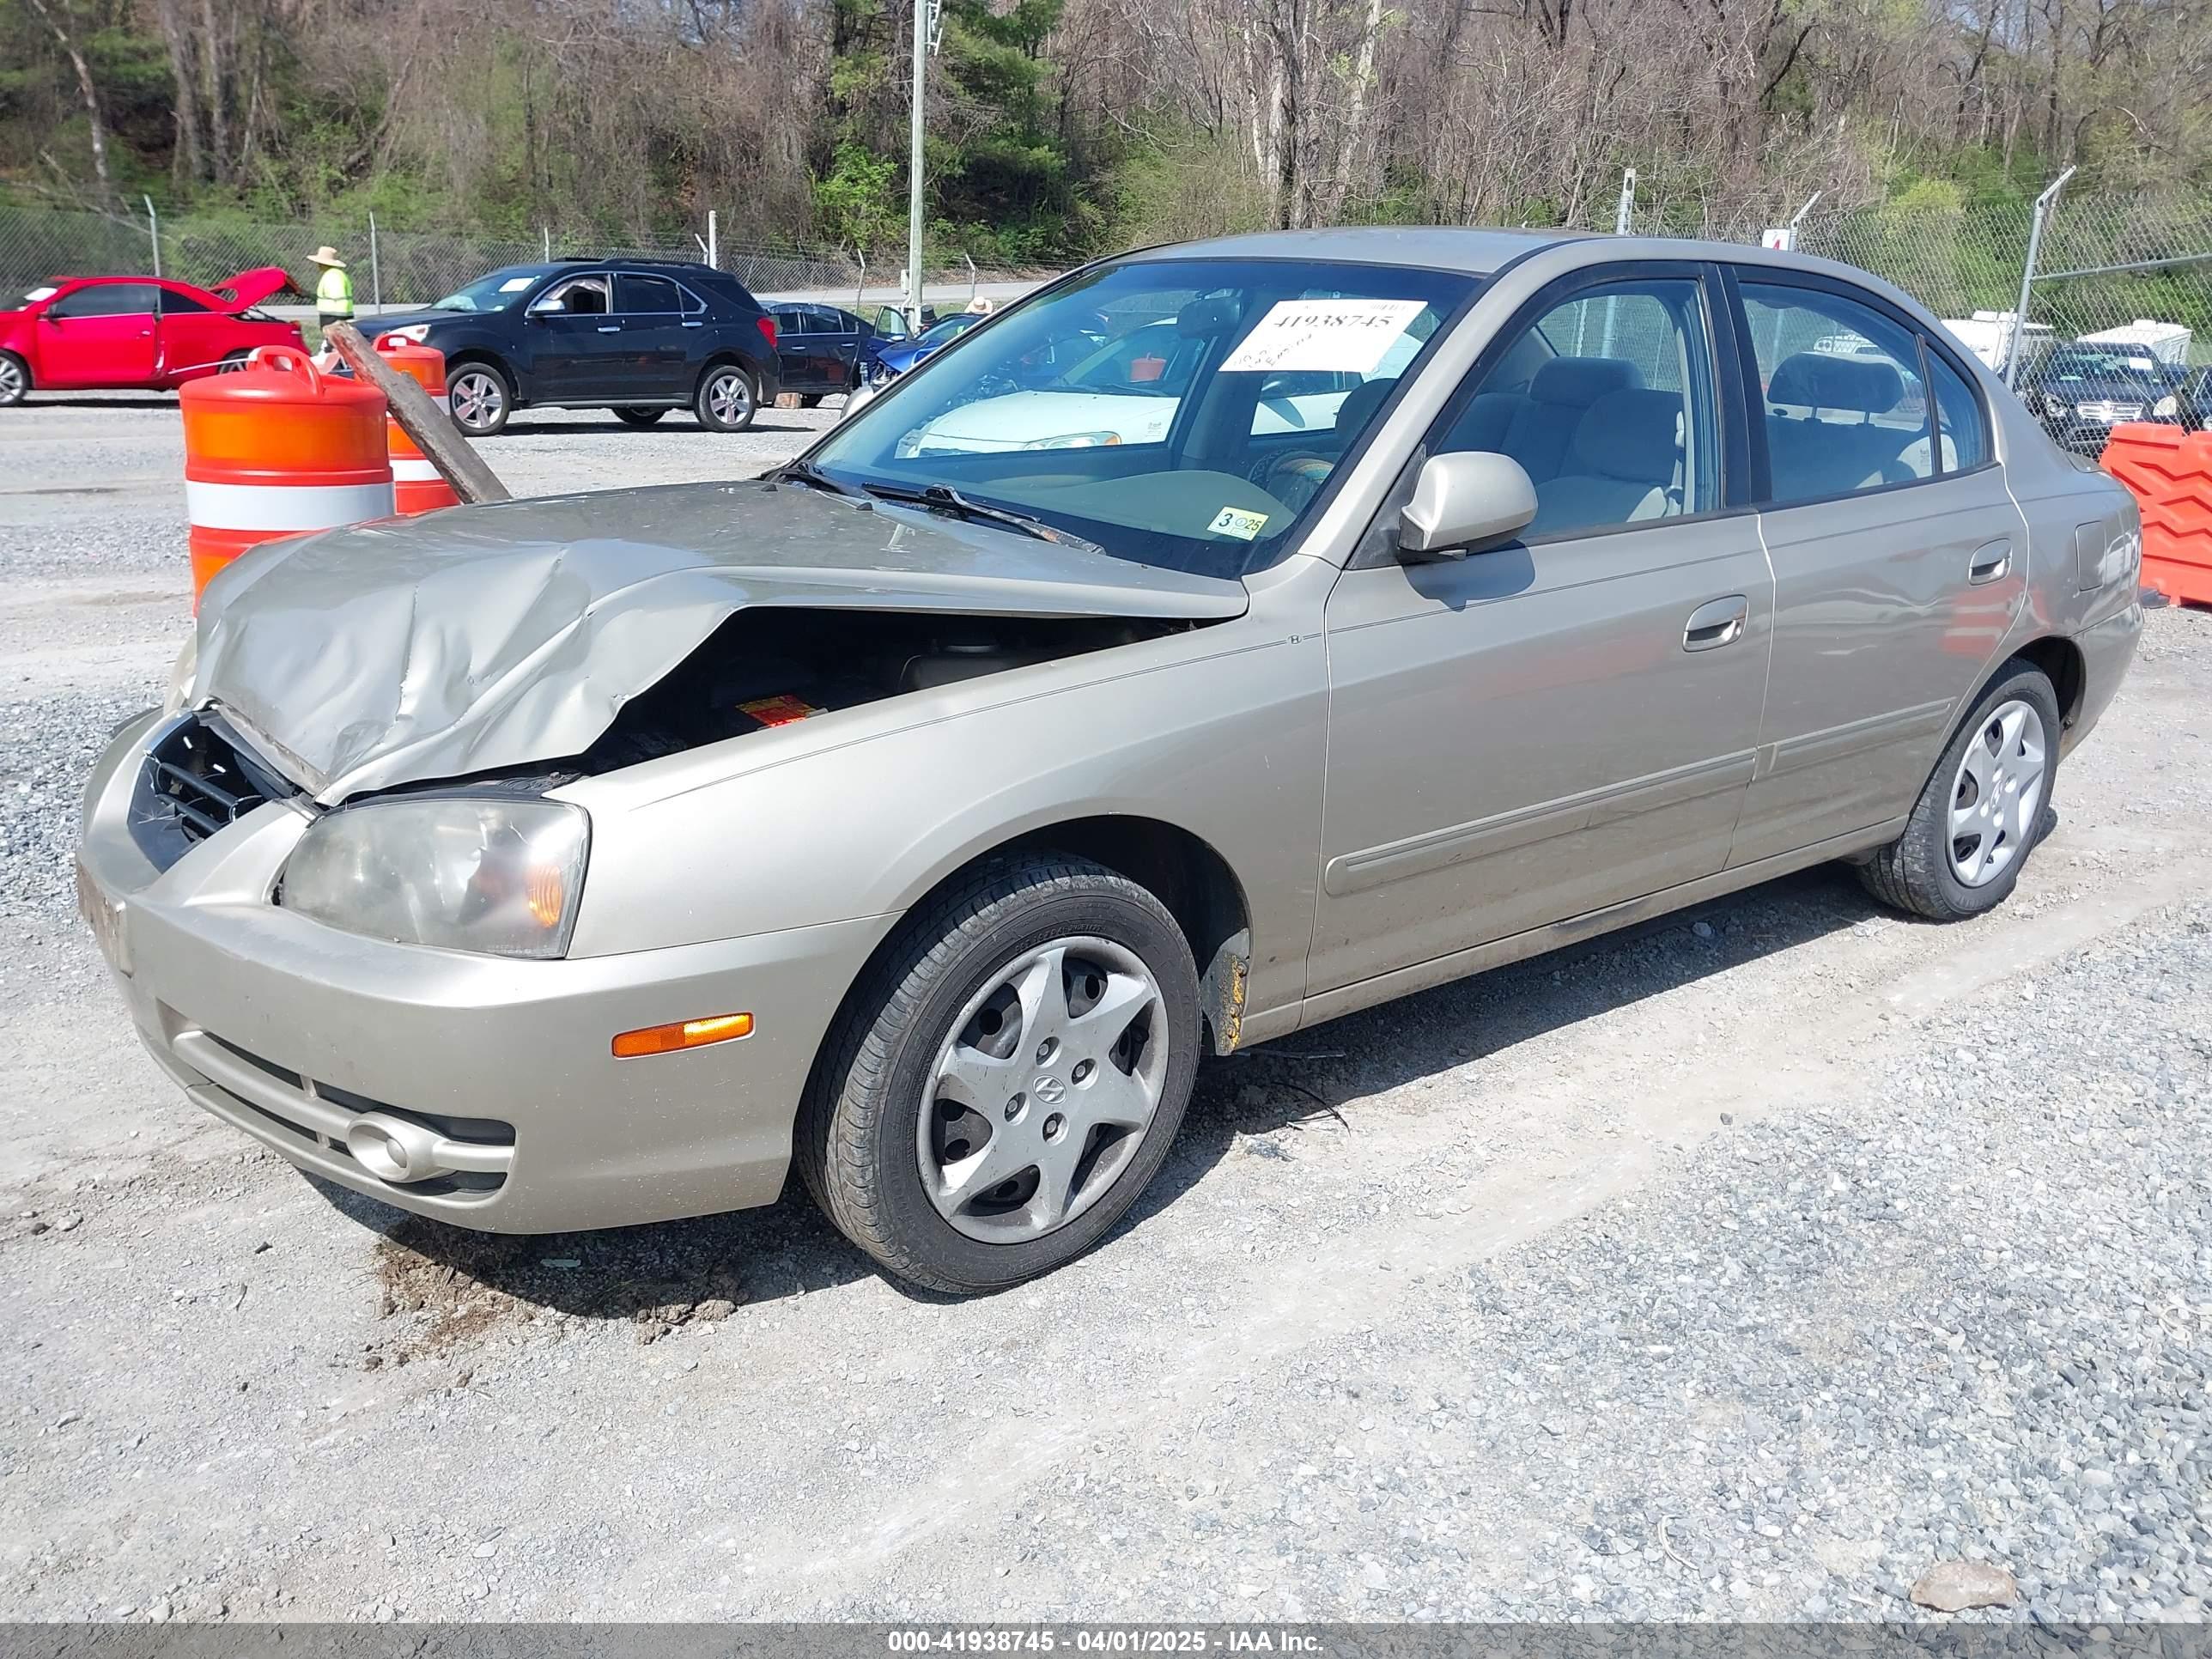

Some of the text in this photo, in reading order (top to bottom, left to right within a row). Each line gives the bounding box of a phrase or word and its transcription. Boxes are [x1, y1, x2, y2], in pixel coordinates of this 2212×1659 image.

[1273, 315, 1395, 328] 41938745
[1218, 513, 1262, 531] 3 25
